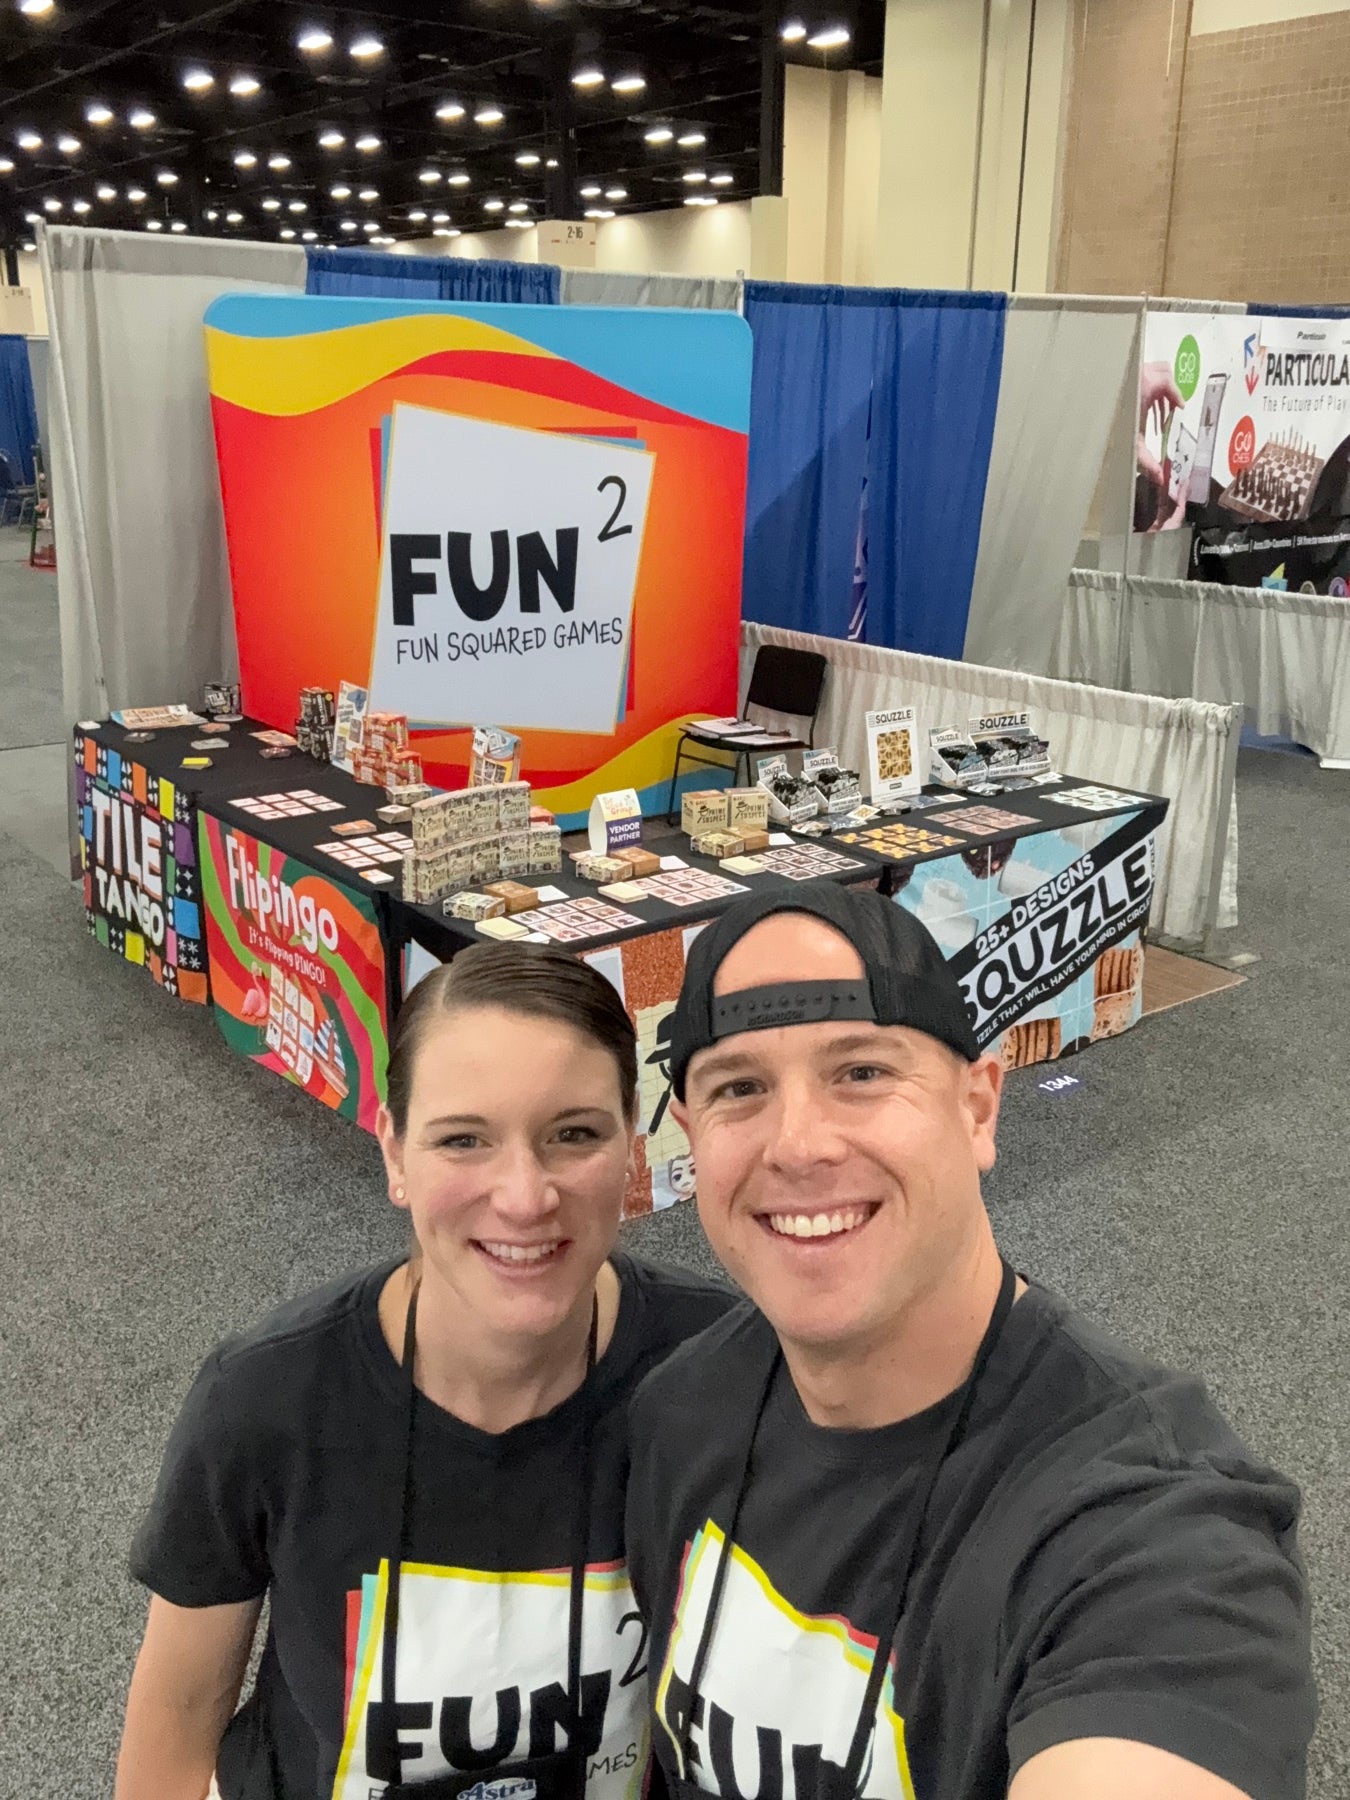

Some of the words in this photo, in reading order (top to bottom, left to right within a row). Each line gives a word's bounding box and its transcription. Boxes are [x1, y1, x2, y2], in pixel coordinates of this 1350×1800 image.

[1265, 353, 1350, 386] PARTICULA
[1235, 431, 1251, 452] GO
[597, 475, 633, 543] 2
[390, 527, 579, 626] FUN
[397, 633, 439, 664] FUN
[447, 627, 547, 662] SQUARED
[553, 617, 623, 649] GAMES
[876, 710, 912, 724] SQUZZLE
[979, 714, 1027, 730] SQUZZLE
[810, 757, 836, 767] SQUZZLE
[92, 787, 162, 901] TILE
[609, 821, 640, 834] VENDOR
[609, 831, 641, 843] PARTNER
[96, 866, 165, 947] TANGO
[225, 833, 338, 954] Flipingo
[975, 925, 1010, 960] 25+
[1012, 853, 1095, 930] DESIGNS
[294, 952, 327, 988] BINGO!
[998, 998, 1025, 1022] THAT
[1025, 981, 1051, 1002] WILL
[1050, 964, 1076, 987] HAVE
[1075, 942, 1098, 967] YOUR
[1095, 926, 1117, 949] MIND
[1116, 919, 1127, 932] IN
[366, 1670, 611, 1785] FUN
[588, 1743, 637, 1779] MES
